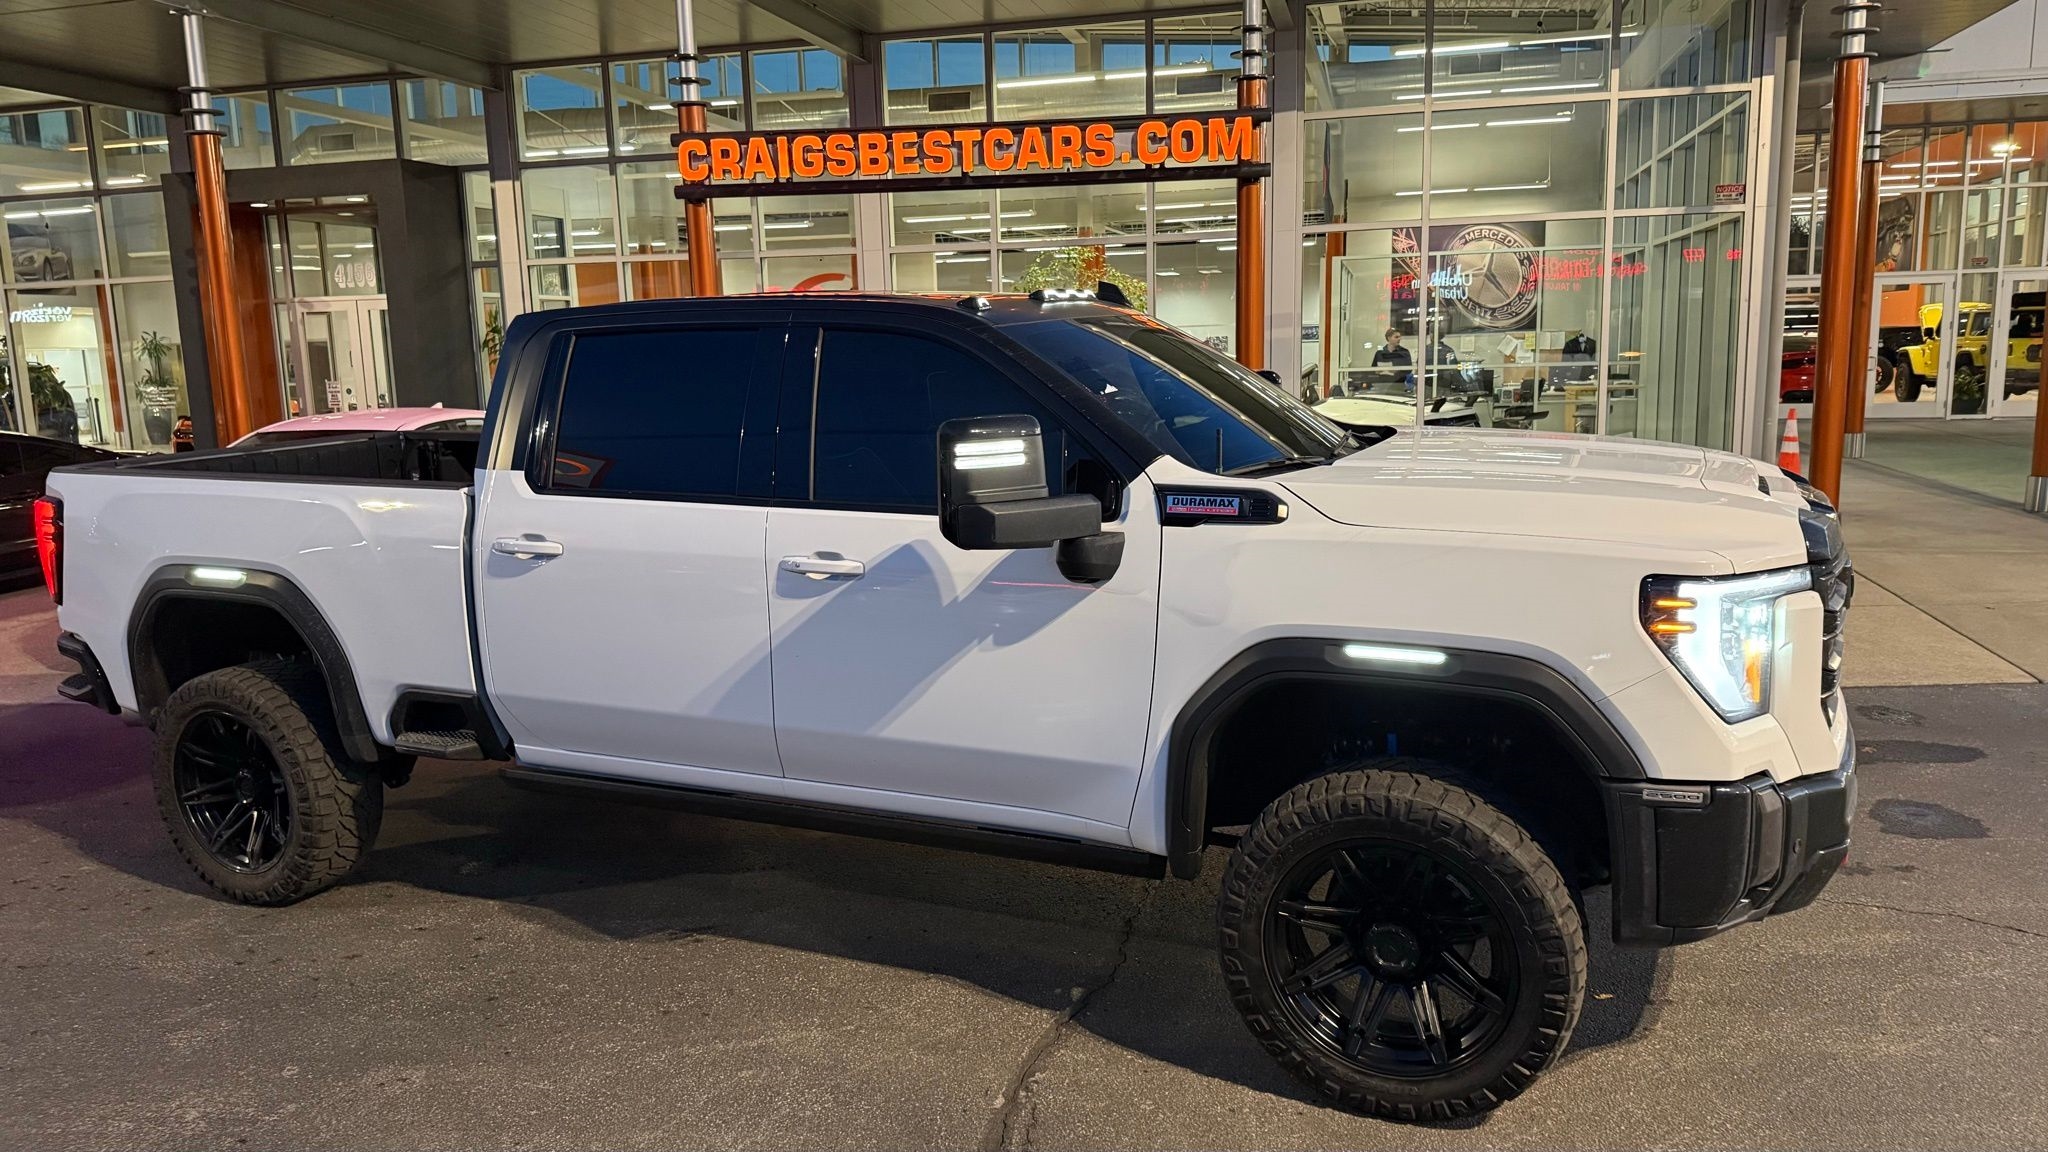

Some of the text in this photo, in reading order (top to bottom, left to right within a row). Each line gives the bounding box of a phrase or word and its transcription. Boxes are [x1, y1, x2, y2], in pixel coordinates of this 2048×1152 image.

[678, 116, 1253, 181] CRAIGSBESTCARS.COM
[1716, 185, 1744, 193] NOTICE
[1465, 229, 1527, 260] MERCEDES
[1172, 497, 1234, 508] DURAMAX
[1643, 789, 1703, 803] 2500
